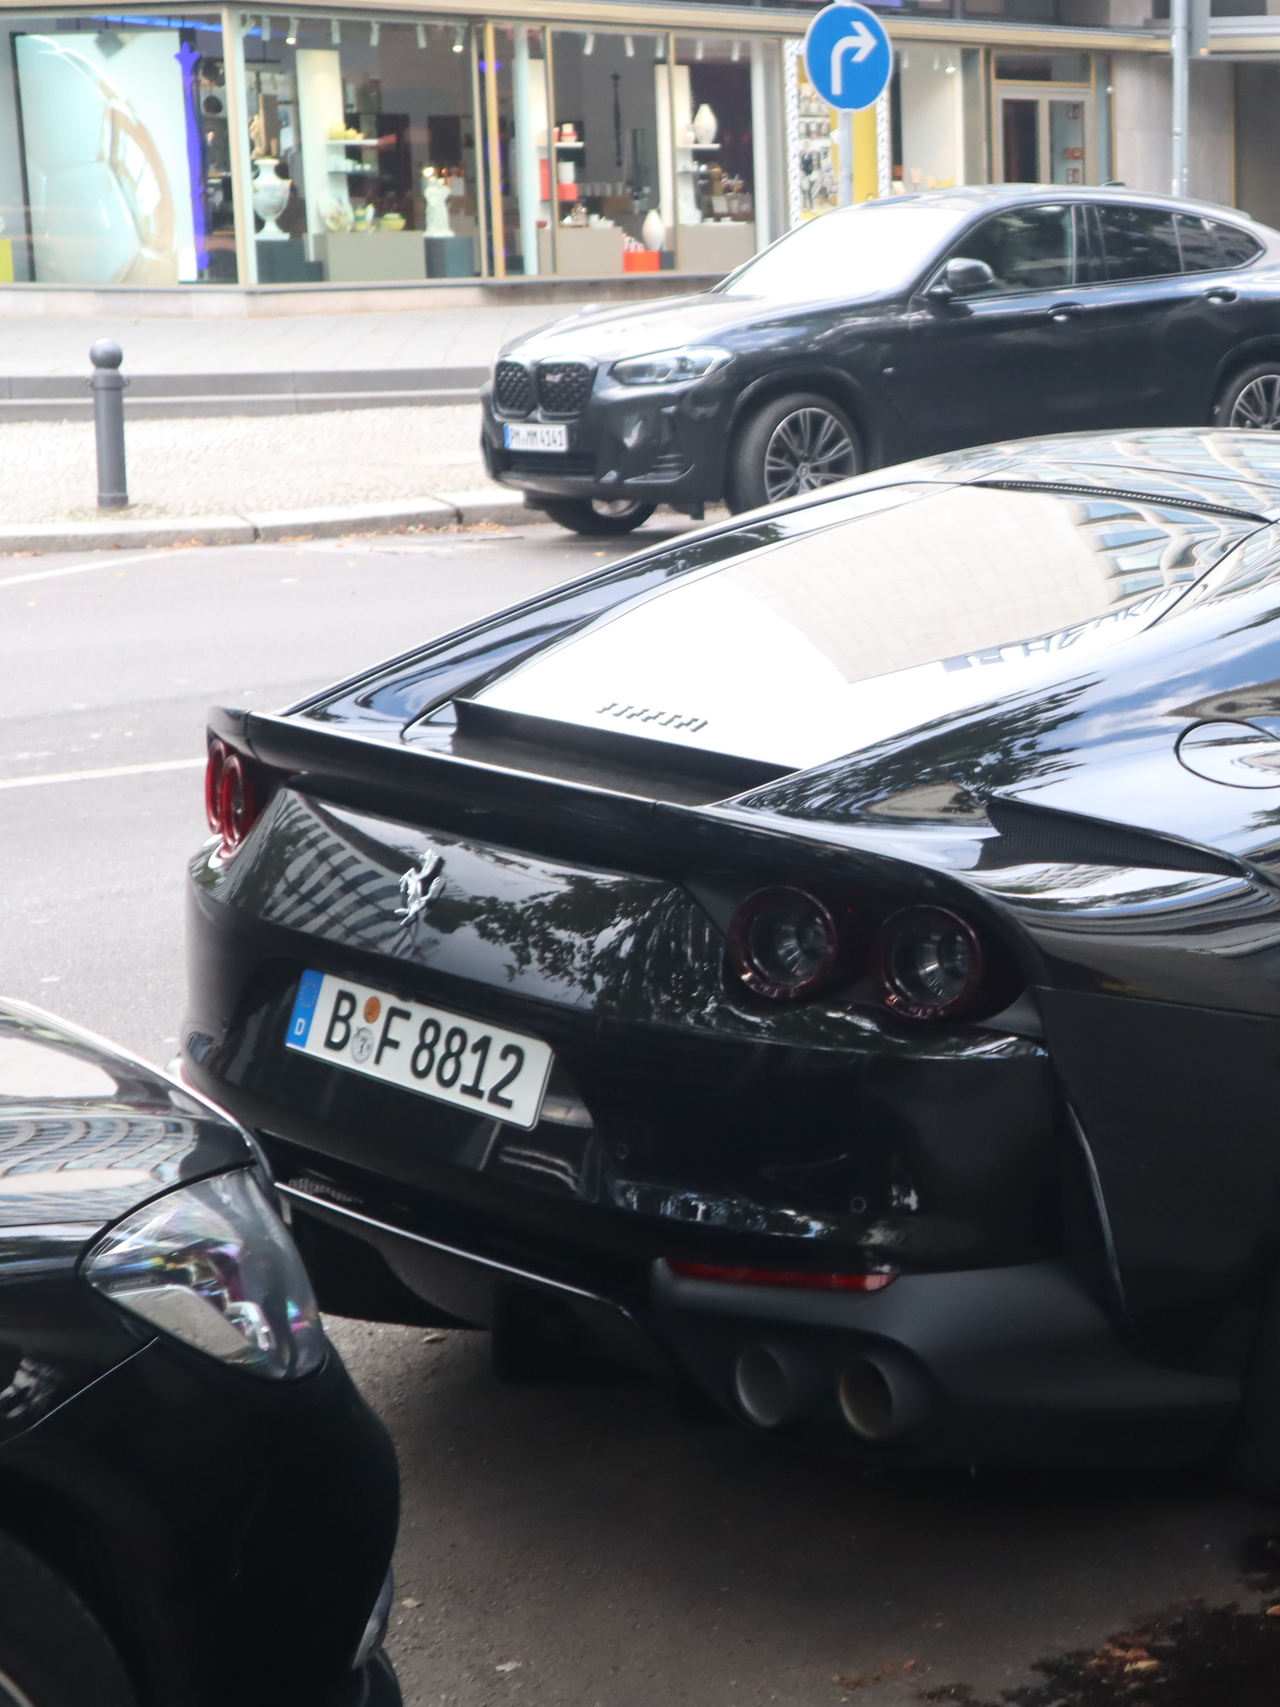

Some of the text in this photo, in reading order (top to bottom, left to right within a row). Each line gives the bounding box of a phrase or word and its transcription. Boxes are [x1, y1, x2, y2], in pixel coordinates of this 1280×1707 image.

[541, 429, 565, 447] 4141
[294, 989, 525, 1109] D B F 8812
